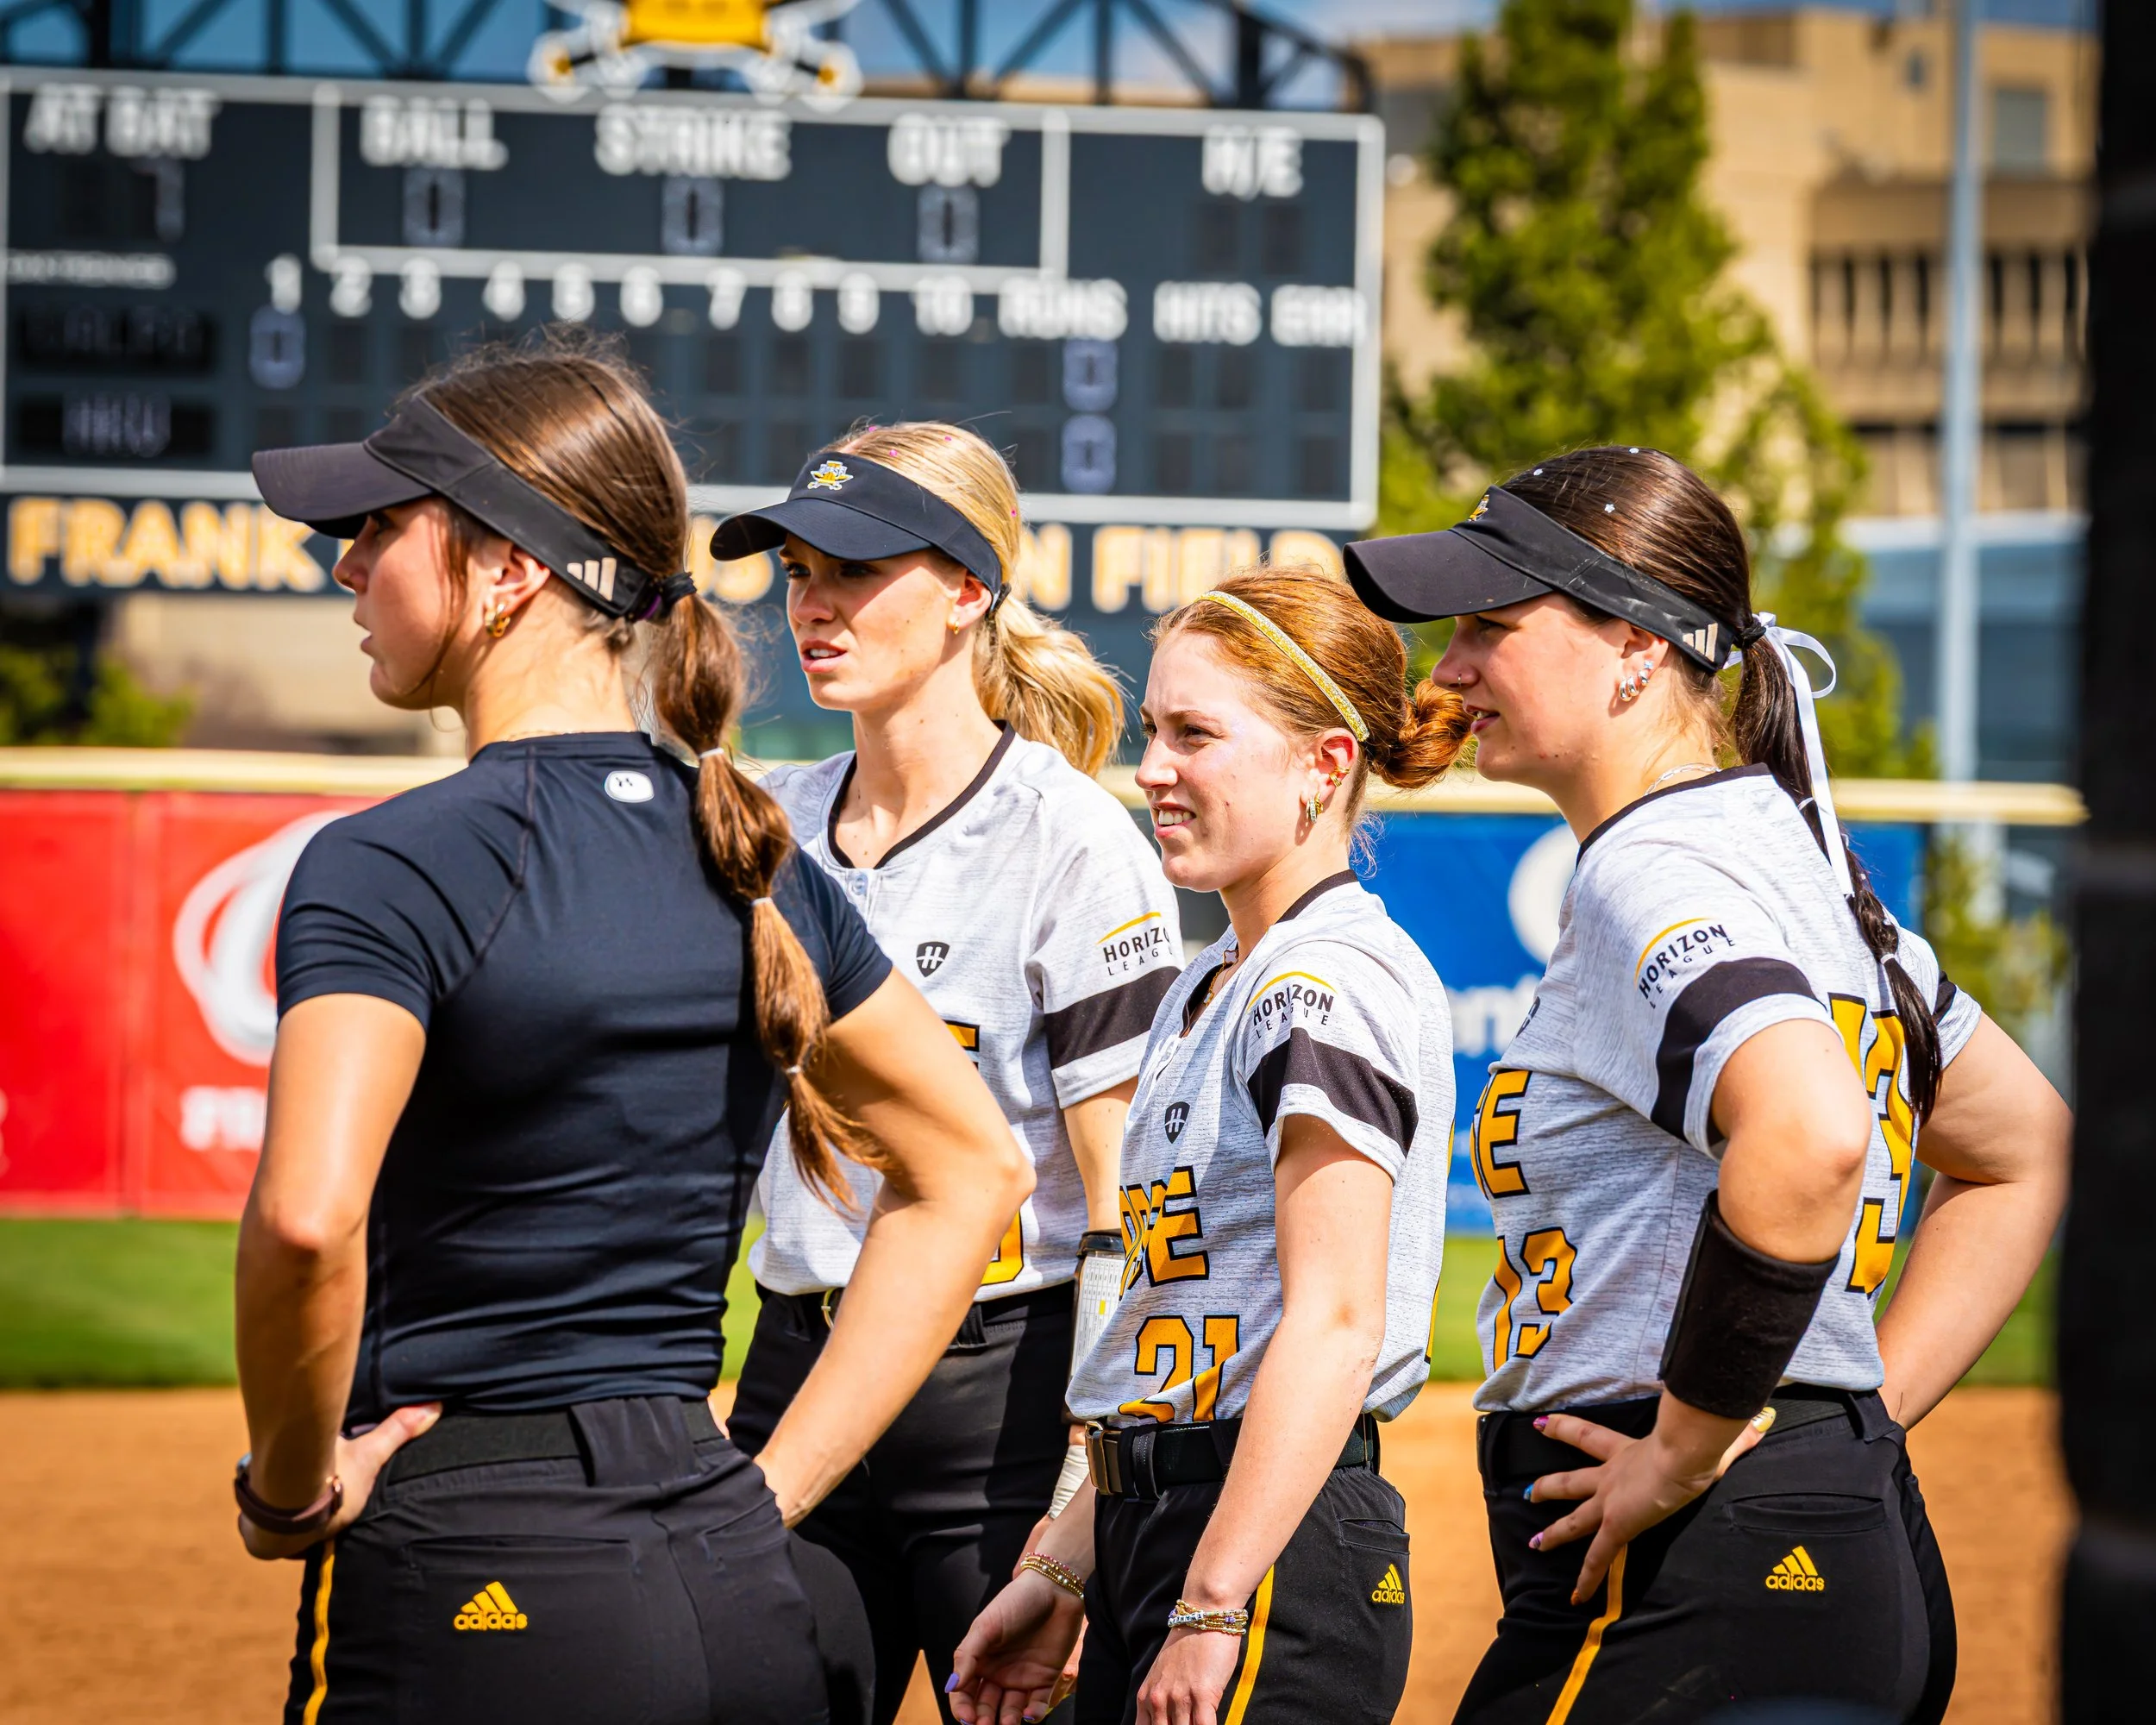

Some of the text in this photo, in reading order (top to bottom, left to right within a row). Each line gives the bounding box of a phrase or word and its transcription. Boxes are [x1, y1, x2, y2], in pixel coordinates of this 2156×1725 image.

[105, 85, 220, 160] BAT
[360, 95, 509, 171] BALL
[594, 104, 792, 180] STRIKE
[887, 113, 1010, 187] OUT
[403, 166, 465, 248] 0
[661, 175, 724, 256] 0
[917, 183, 979, 261] 0
[264, 254, 301, 314] 1
[330, 257, 372, 317] 2
[398, 258, 441, 319] 3
[482, 261, 525, 322] 4
[552, 264, 594, 323] 5
[620, 267, 663, 327] 6
[705, 267, 747, 329] 7
[770, 271, 812, 332] 8
[836, 273, 879, 335] 9
[911, 276, 974, 336] 10
[998, 278, 1128, 341] RUNS
[7, 496, 328, 593] FRANK
[1089, 524, 1344, 613] FIELD
[1103, 927, 1170, 963] HORIZ
[1639, 925, 1727, 1000] HORIZON
[1649, 938, 1736, 1009] LEAGUE
[1253, 984, 1334, 1026] HORIZON
[1257, 1002, 1328, 1038] LEAGUE
[1118, 1314, 1240, 1422] 21
[1765, 1571, 1825, 1591] adidas
[454, 1610, 528, 1631] adidas
